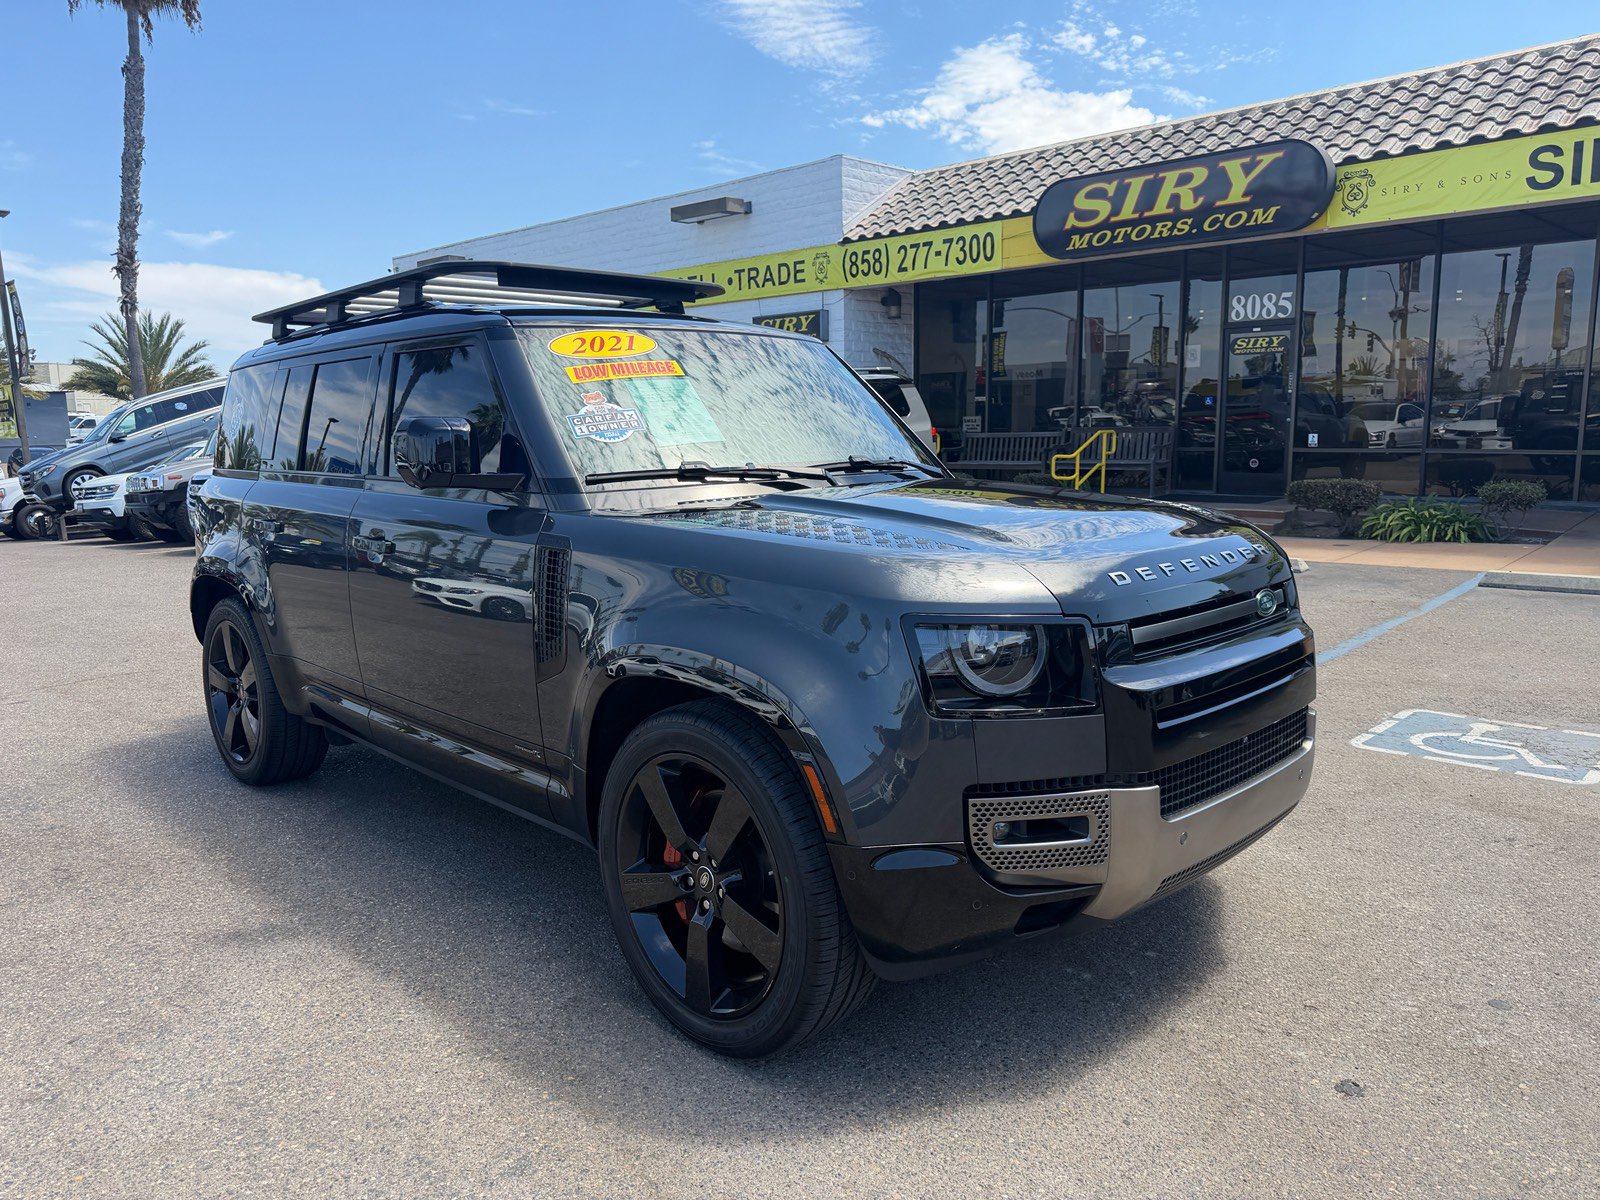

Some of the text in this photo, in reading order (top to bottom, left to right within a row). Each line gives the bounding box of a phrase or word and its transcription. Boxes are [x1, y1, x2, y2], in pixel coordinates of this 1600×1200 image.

[1063, 150, 1285, 231] SIRY
[1381, 170, 1513, 197] SIRY & SONS
[1065, 206, 1281, 252] MOTORS.COM
[734, 231, 996, 290] TRADE (858) 277-7300
[1231, 291, 1293, 321] 8085
[572, 335, 636, 354] 2021
[1233, 335, 1286, 349] SIRY
[573, 361, 676, 381] LOW MILEAGE
[573, 413, 636, 425] CARFAX
[1107, 543, 1269, 586] DEFENDER
